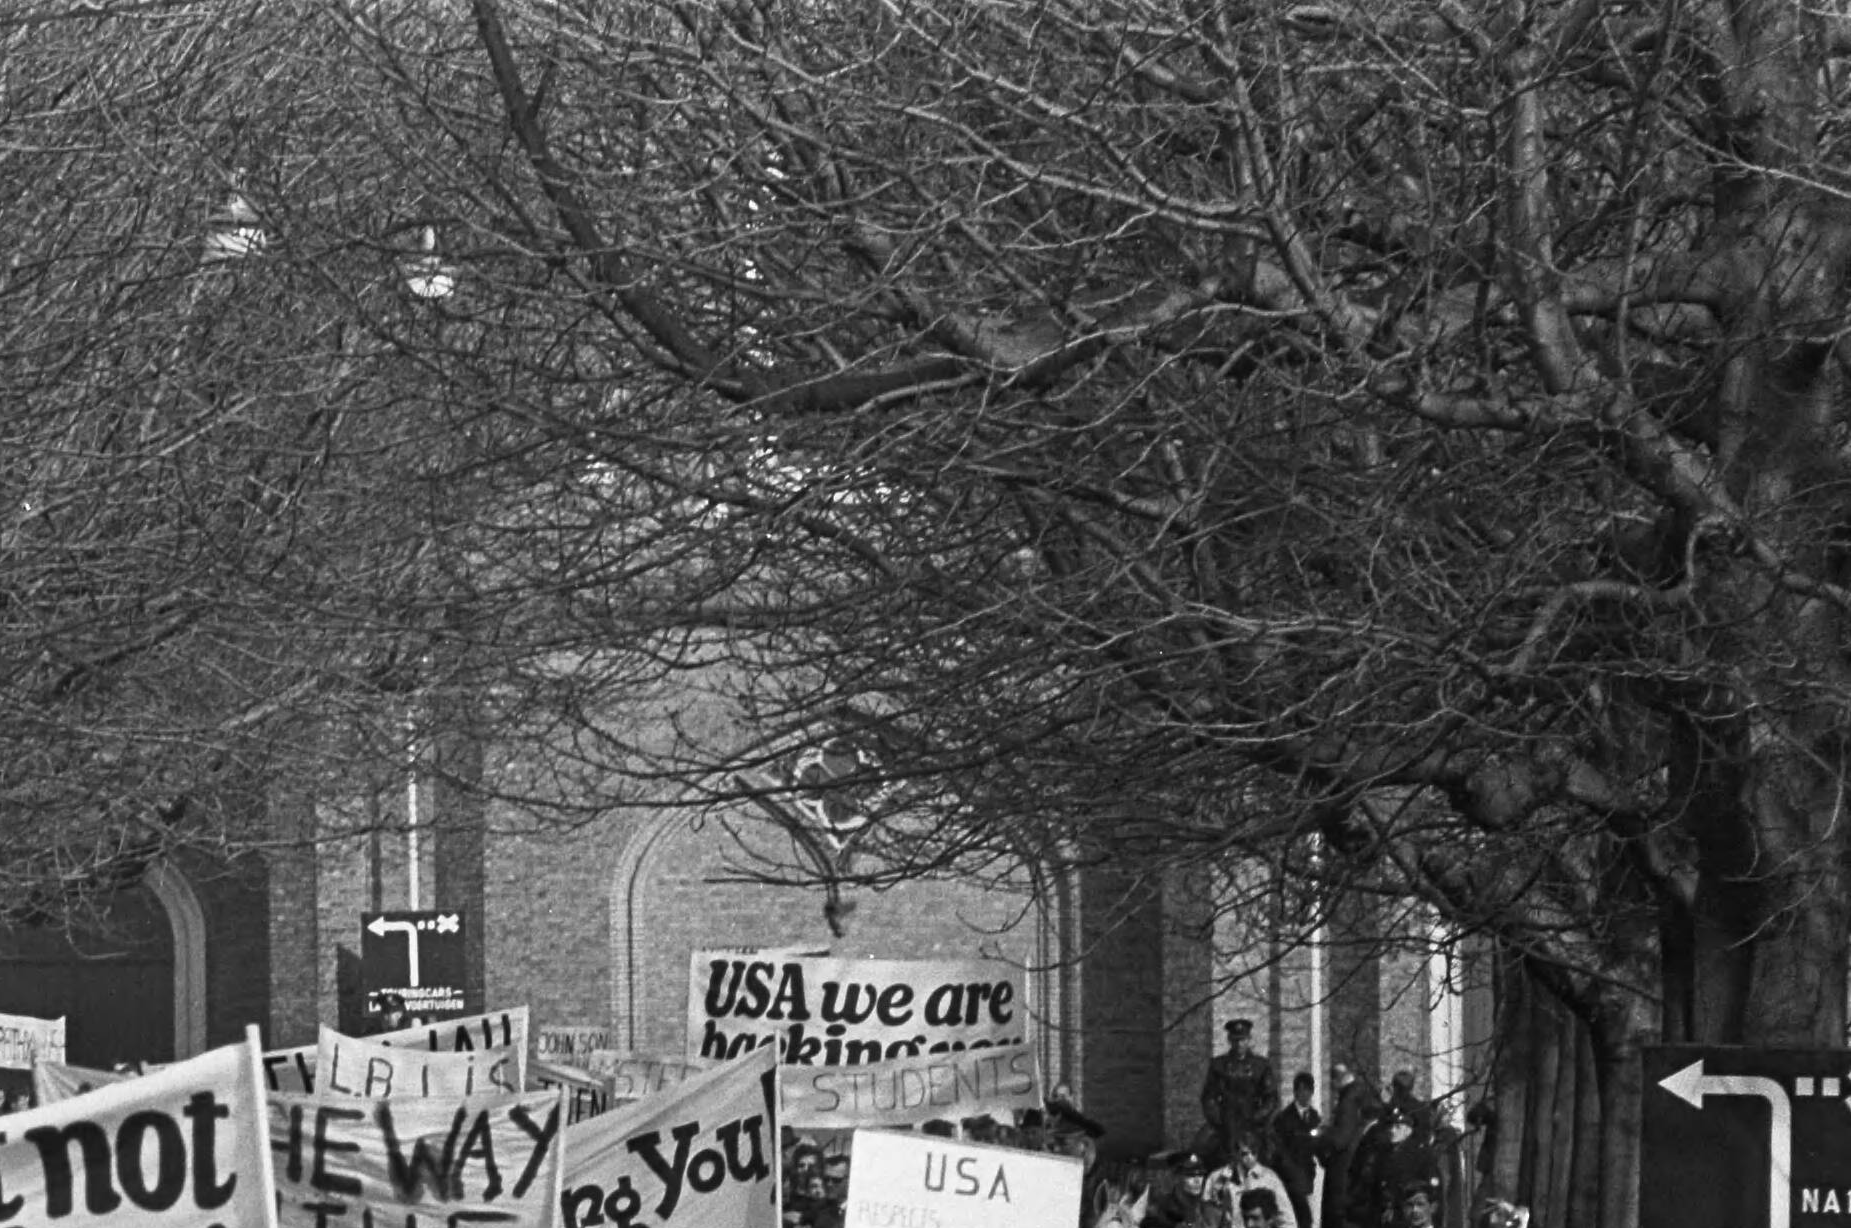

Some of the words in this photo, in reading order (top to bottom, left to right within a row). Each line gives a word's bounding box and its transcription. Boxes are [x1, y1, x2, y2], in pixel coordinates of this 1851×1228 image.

[704, 960, 811, 1021] USA
[821, 981, 914, 1027] we
[924, 978, 1014, 1027] are
[812, 1053, 1032, 1112] STUDENTS
[25, 1091, 237, 1218] not
[374, 1101, 561, 1201] WAY
[924, 1152, 1011, 1204] USA
